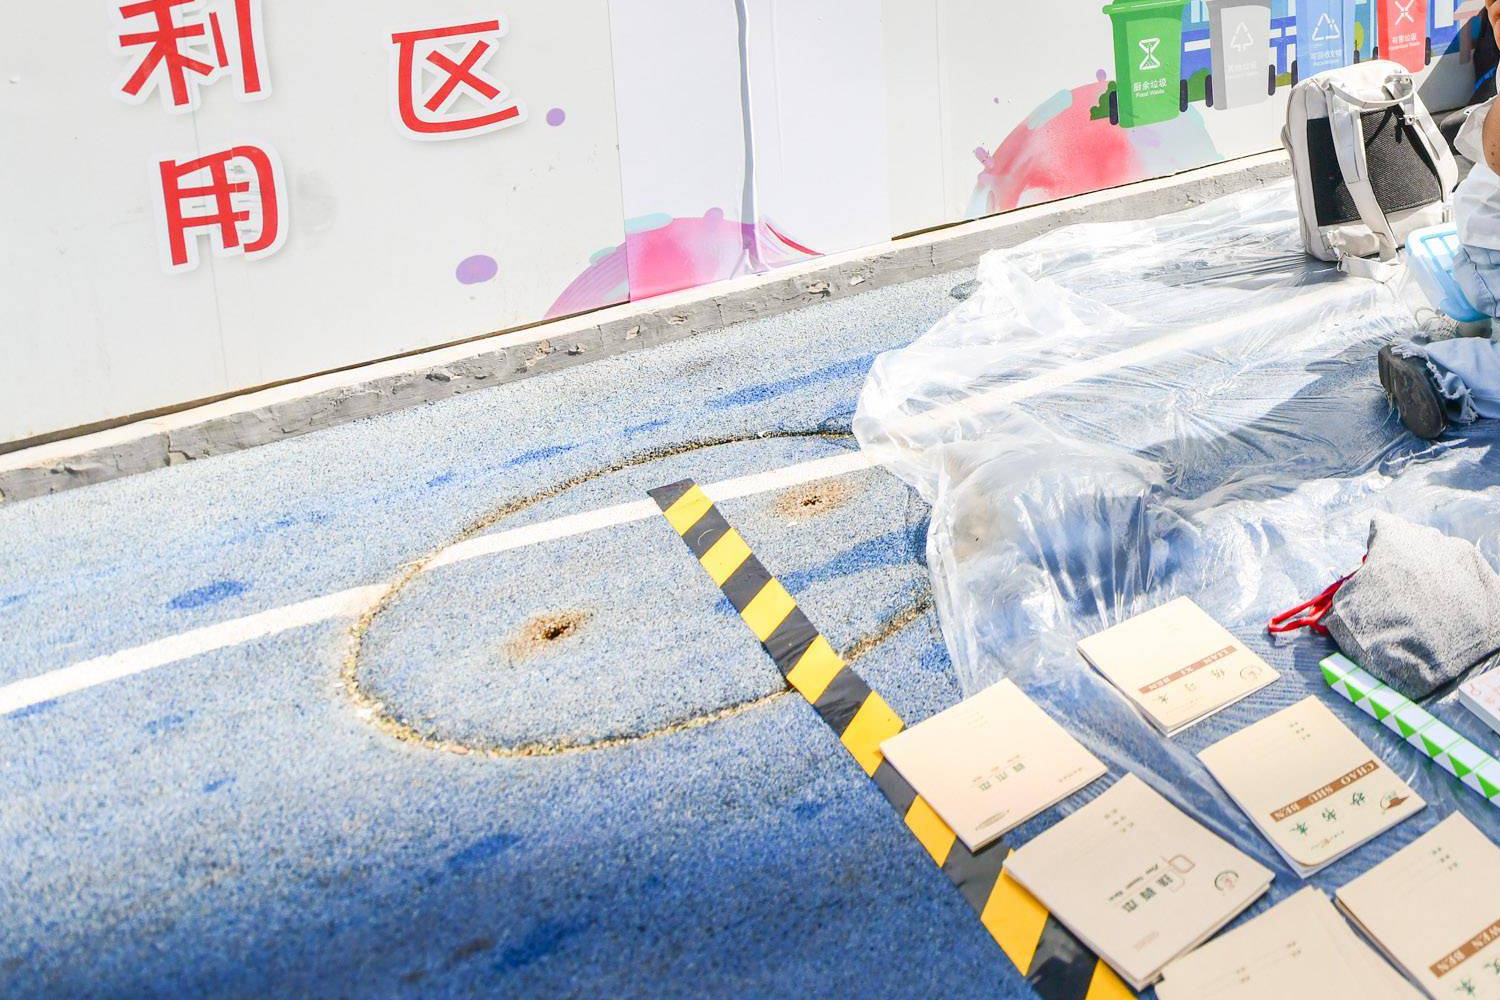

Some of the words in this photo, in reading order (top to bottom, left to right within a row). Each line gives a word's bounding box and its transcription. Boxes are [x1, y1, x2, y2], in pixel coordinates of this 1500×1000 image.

[1341, 762, 1375, 785] CHAO
[1308, 786, 1334, 803] SHU
[1274, 802, 1300, 820] BEN
[1436, 950, 1466, 974] BEN
